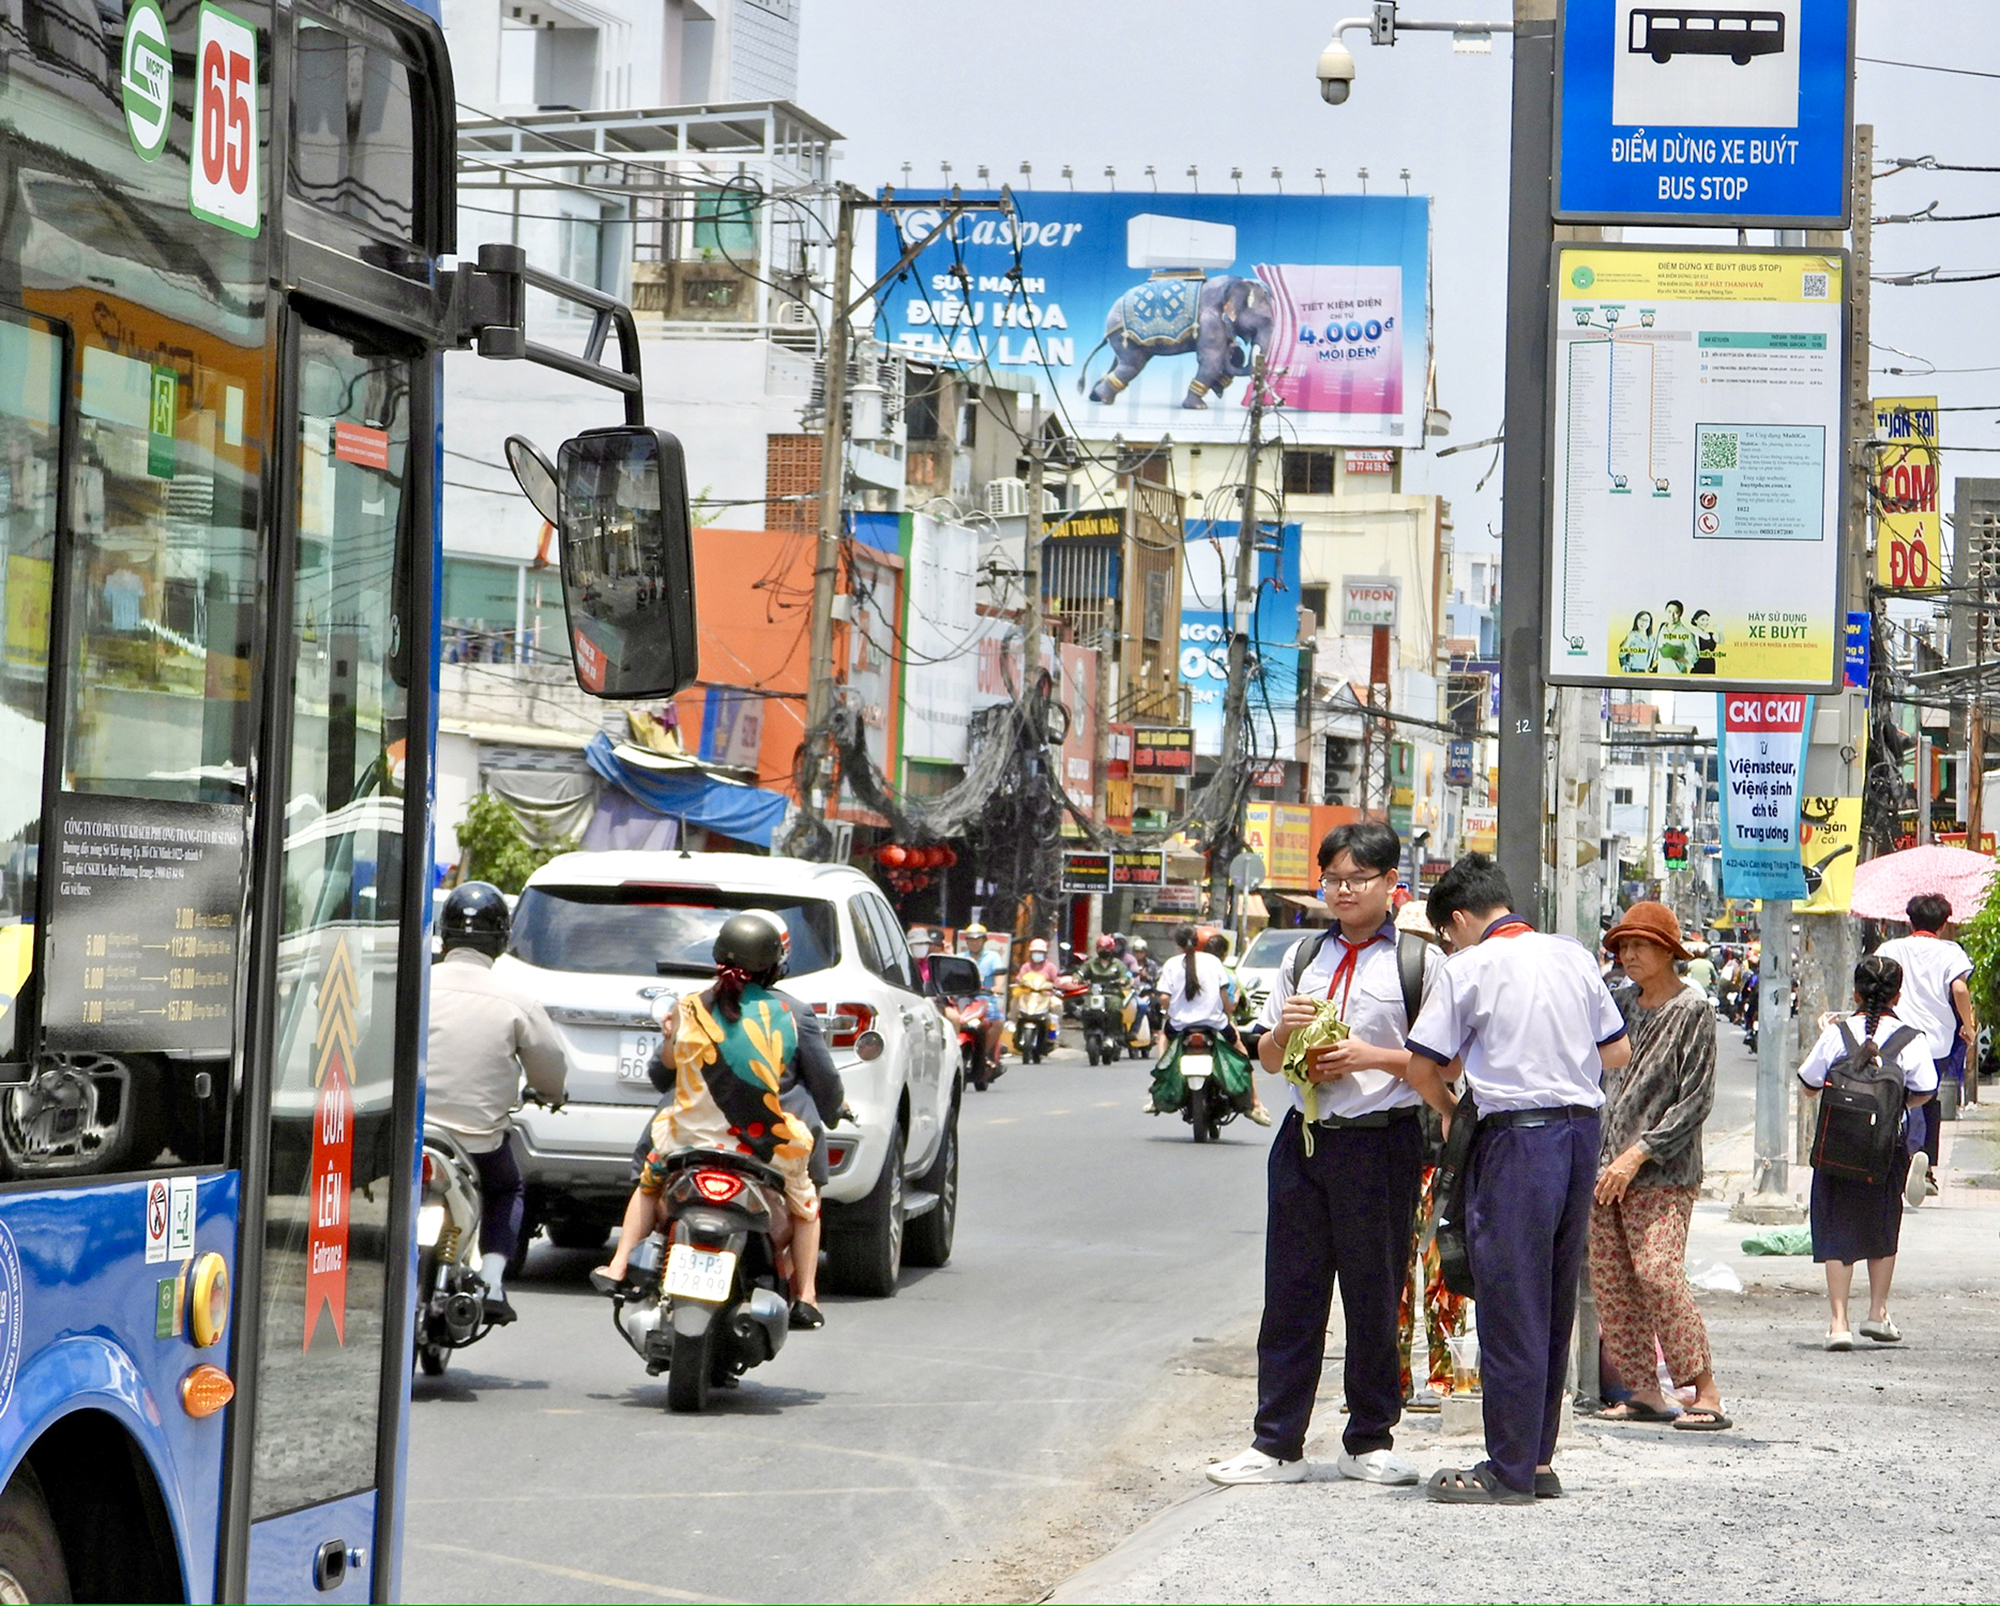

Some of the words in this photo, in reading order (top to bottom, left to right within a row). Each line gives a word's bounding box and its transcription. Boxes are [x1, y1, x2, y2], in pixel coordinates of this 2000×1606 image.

[202, 40, 250, 195] 65
[1612, 128, 1657, 163] ĐIỂM
[1663, 132, 1716, 164] DỪNG
[1721, 140, 1745, 164] XE
[1750, 133, 1799, 165] BUÝT
[1658, 176, 1696, 200] BUS
[1700, 176, 1749, 201] STOP
[945, 212, 1083, 255] Casper
[1704, 262, 1714, 271] XE
[1738, 263, 1757, 272] (BUS
[1758, 263, 1782, 273] STOP)
[906, 289, 985, 327] ĐIỀU
[998, 335, 1075, 366] LAN
[1890, 521, 1929, 588] ĐỒ
[1350, 589, 1394, 602] VIFON
[1748, 625, 1766, 639] XE
[1771, 622, 1808, 640] BUÝT
[1516, 718, 1532, 734] 12
[1770, 781, 1793, 796] sinh
[322, 1071, 345, 1147] CỬA
[318, 1160, 342, 1230] LÊN
[312, 1241, 343, 1276] Entrance
